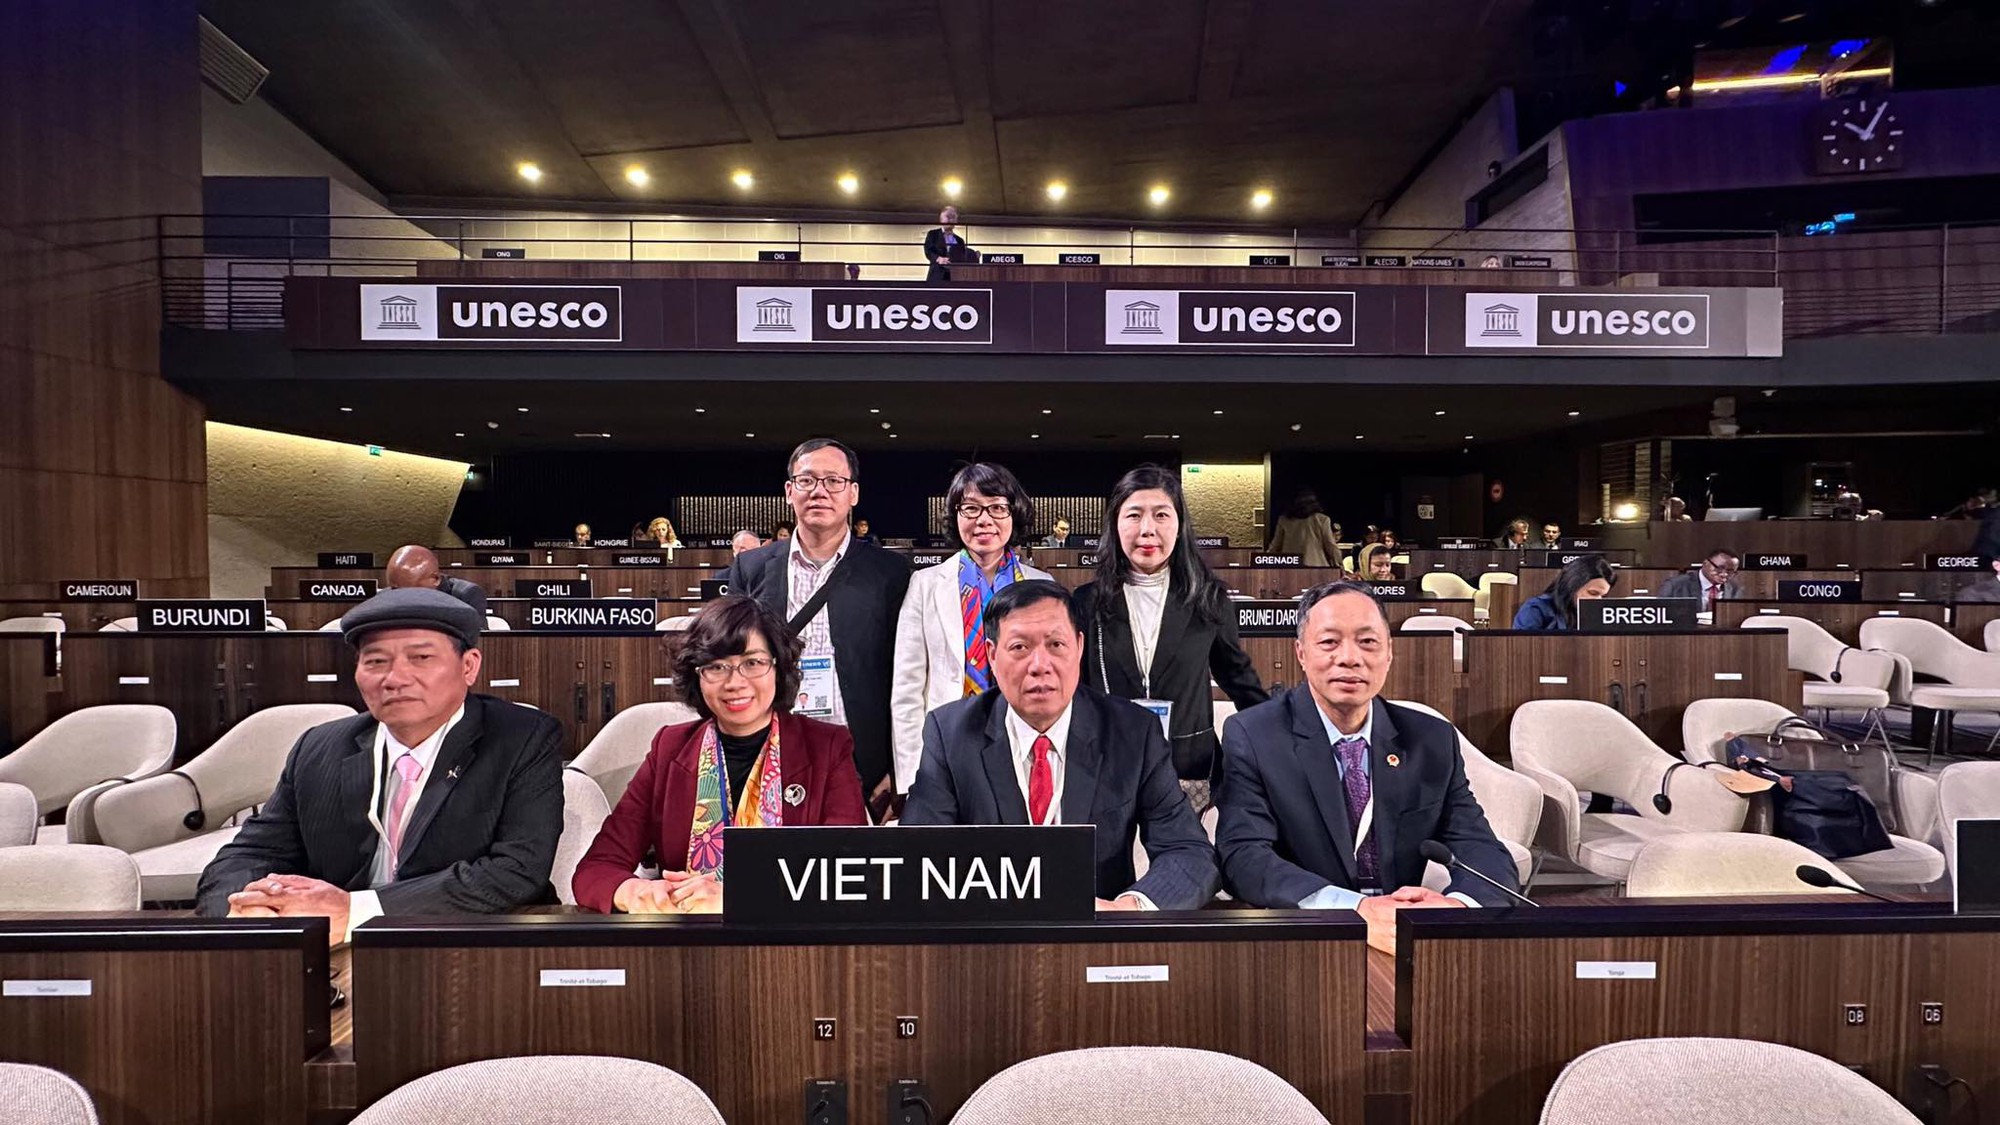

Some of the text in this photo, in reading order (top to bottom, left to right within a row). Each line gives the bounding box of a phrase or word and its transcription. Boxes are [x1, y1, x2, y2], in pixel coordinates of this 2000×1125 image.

[1263, 257, 1277, 265] OCI
[1374, 258, 1398, 266] ALECSO
[452, 301, 608, 328] unesco
[827, 304, 979, 330] unesco
[1193, 307, 1342, 333] unesco
[1551, 310, 1696, 336] unesco
[335, 555, 357, 565] HAITI
[619, 556, 660, 564] GUINEE-BISSAU
[913, 555, 942, 564] GUINEE
[1255, 556, 1299, 565] GRENADE
[1759, 556, 1791, 566] GHANA
[1937, 557, 1979, 567] GEORGIE
[66, 585, 132, 597] CAMEROUN
[310, 585, 366, 596] CANADA
[537, 584, 571, 596] CHILI
[1798, 584, 1841, 598] CONGO
[152, 608, 250, 626] BURUNDI
[531, 608, 654, 625] BURKINA FASO
[1239, 609, 1275, 626] BRUNEI
[1602, 607, 1673, 625] BRESIL
[777, 856, 1041, 901] VIET NAM
[1848, 1010, 1864, 1023] 08
[1925, 1008, 1941, 1021] 06
[818, 1024, 832, 1037] 12
[900, 1022, 915, 1036] 10
